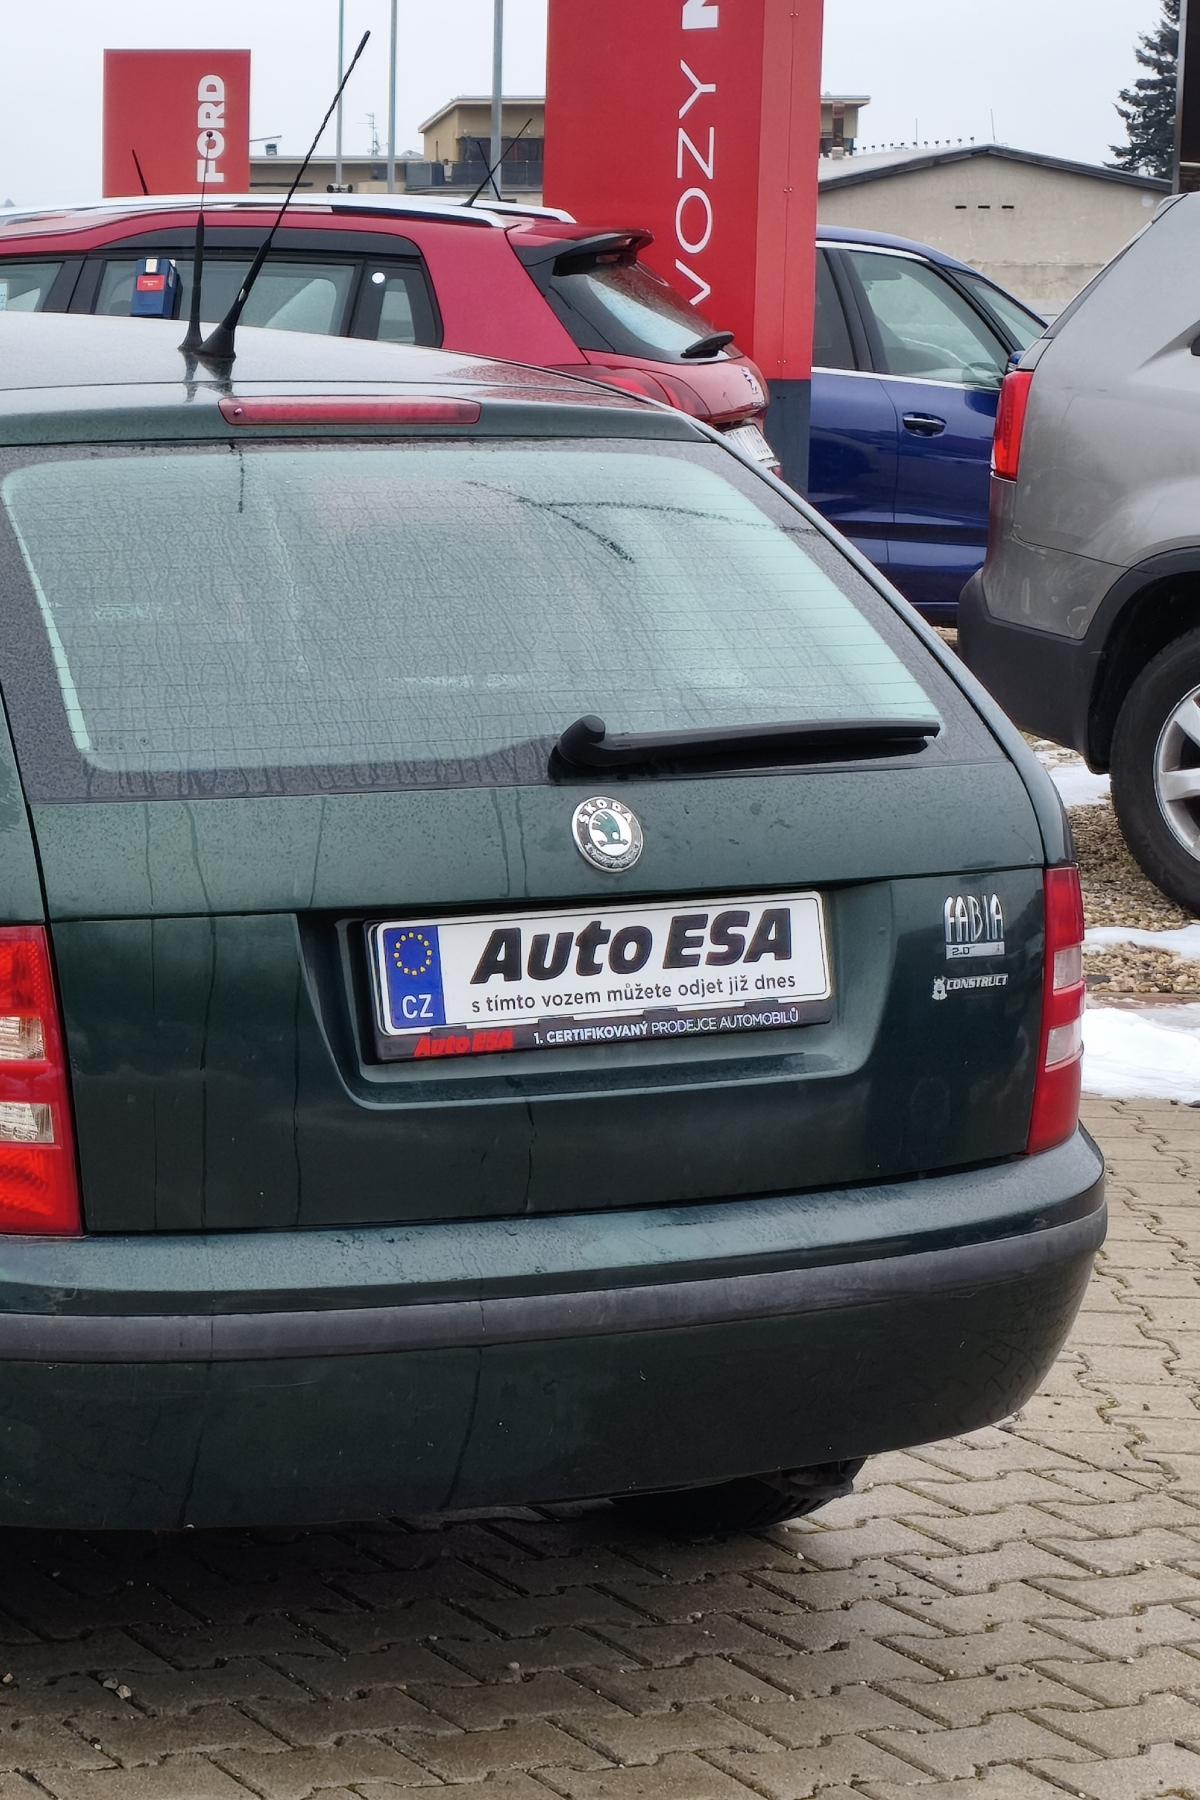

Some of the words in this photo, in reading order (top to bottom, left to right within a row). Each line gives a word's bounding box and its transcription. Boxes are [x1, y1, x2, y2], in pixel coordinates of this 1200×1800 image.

[197, 74, 225, 182] FORD
[675, 59, 716, 306] VOZY
[944, 894, 1004, 942] FABIA
[470, 920, 653, 984] Auto
[662, 907, 792, 970] ESA
[952, 946, 970, 956] 2.0
[472, 1000, 481, 1013] s
[486, 993, 536, 1012] tímto
[541, 991, 601, 1008] vozem
[607, 982, 672, 1002] můžete
[678, 979, 724, 998] odjet
[729, 975, 749, 996] již
[754, 974, 796, 990] dnes
[946, 973, 1009, 991] CONSTRUCT
[401, 993, 434, 1019] CZ
[533, 1031, 545, 1045] 1.
[546, 1020, 648, 1044] CERTIFIKOVANÝ
[651, 1016, 717, 1035] PRODEJCE
[719, 1006, 800, 1030] AUTOMOBILŮ
